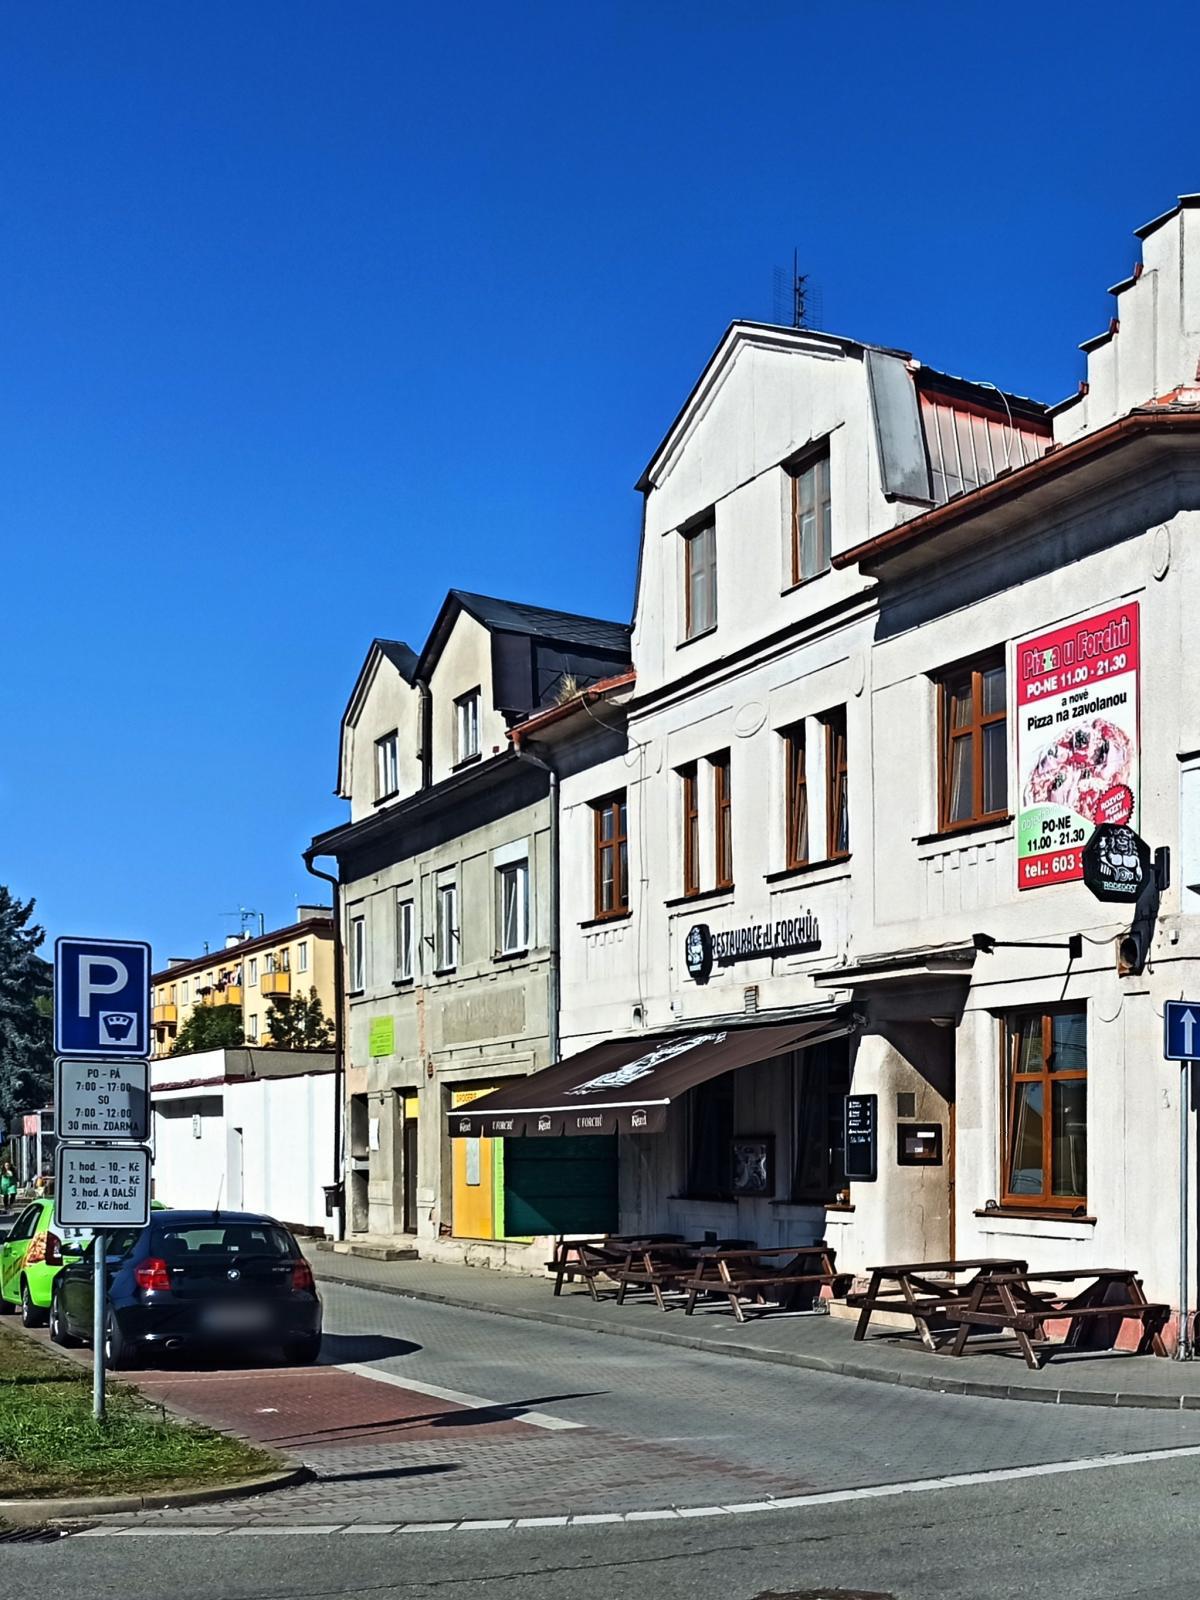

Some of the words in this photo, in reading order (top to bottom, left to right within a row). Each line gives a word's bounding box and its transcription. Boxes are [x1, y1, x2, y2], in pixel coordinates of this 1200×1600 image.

[1023, 646, 1060, 680] Pizza
[1063, 641, 1074, 666] u
[1077, 615, 1130, 661] Forchů
[1026, 676, 1058, 698] PO-NE
[1061, 666, 1088, 687] 11.00
[1096, 653, 1127, 676] 21.30
[1061, 697, 1067, 707] a
[1069, 688, 1089, 704] nové
[1027, 714, 1053, 731] Pizza
[1056, 709, 1069, 723] na
[1072, 692, 1127, 719] zavolanou
[1101, 790, 1126, 810] ROZVOZ
[1042, 815, 1071, 834] PO-NE
[1027, 836, 1052, 852] 11.00
[1060, 828, 1085, 846] 21.30
[1025, 861, 1049, 878] tel.:
[1052, 854, 1075, 871] 603
[1103, 881, 1138, 893] RADEGAST
[711, 924, 762, 959] RESTAURACE
[79, 954, 128, 1017] P
[88, 1069, 99, 1078] PO
[110, 1068, 120, 1079] PÁ
[76, 1082, 96, 1091] 7:00
[107, 1083, 131, 1092] 17:00
[98, 1095, 109, 1104] SO
[75, 1108, 95, 1117] 7:00
[107, 1109, 131, 1118] 12:00
[68, 1121, 78, 1130] 30
[82, 1122, 100, 1130] min.
[104, 1121, 139, 1131] ZDARMA
[69, 1162, 76, 1170] 1.
[79, 1162, 97, 1171] hod.
[129, 1162, 140, 1171] Kč
[68, 1174, 76, 1184] 2.
[79, 1175, 97, 1184] hod.
[129, 1175, 140, 1184] Kč
[71, 1188, 79, 1197] 3.
[82, 1188, 100, 1197] hod.
[103, 1188, 109, 1197] A
[112, 1186, 136, 1197] DALŠÍ
[98, 1201, 131, 1210] Kč/hod.
